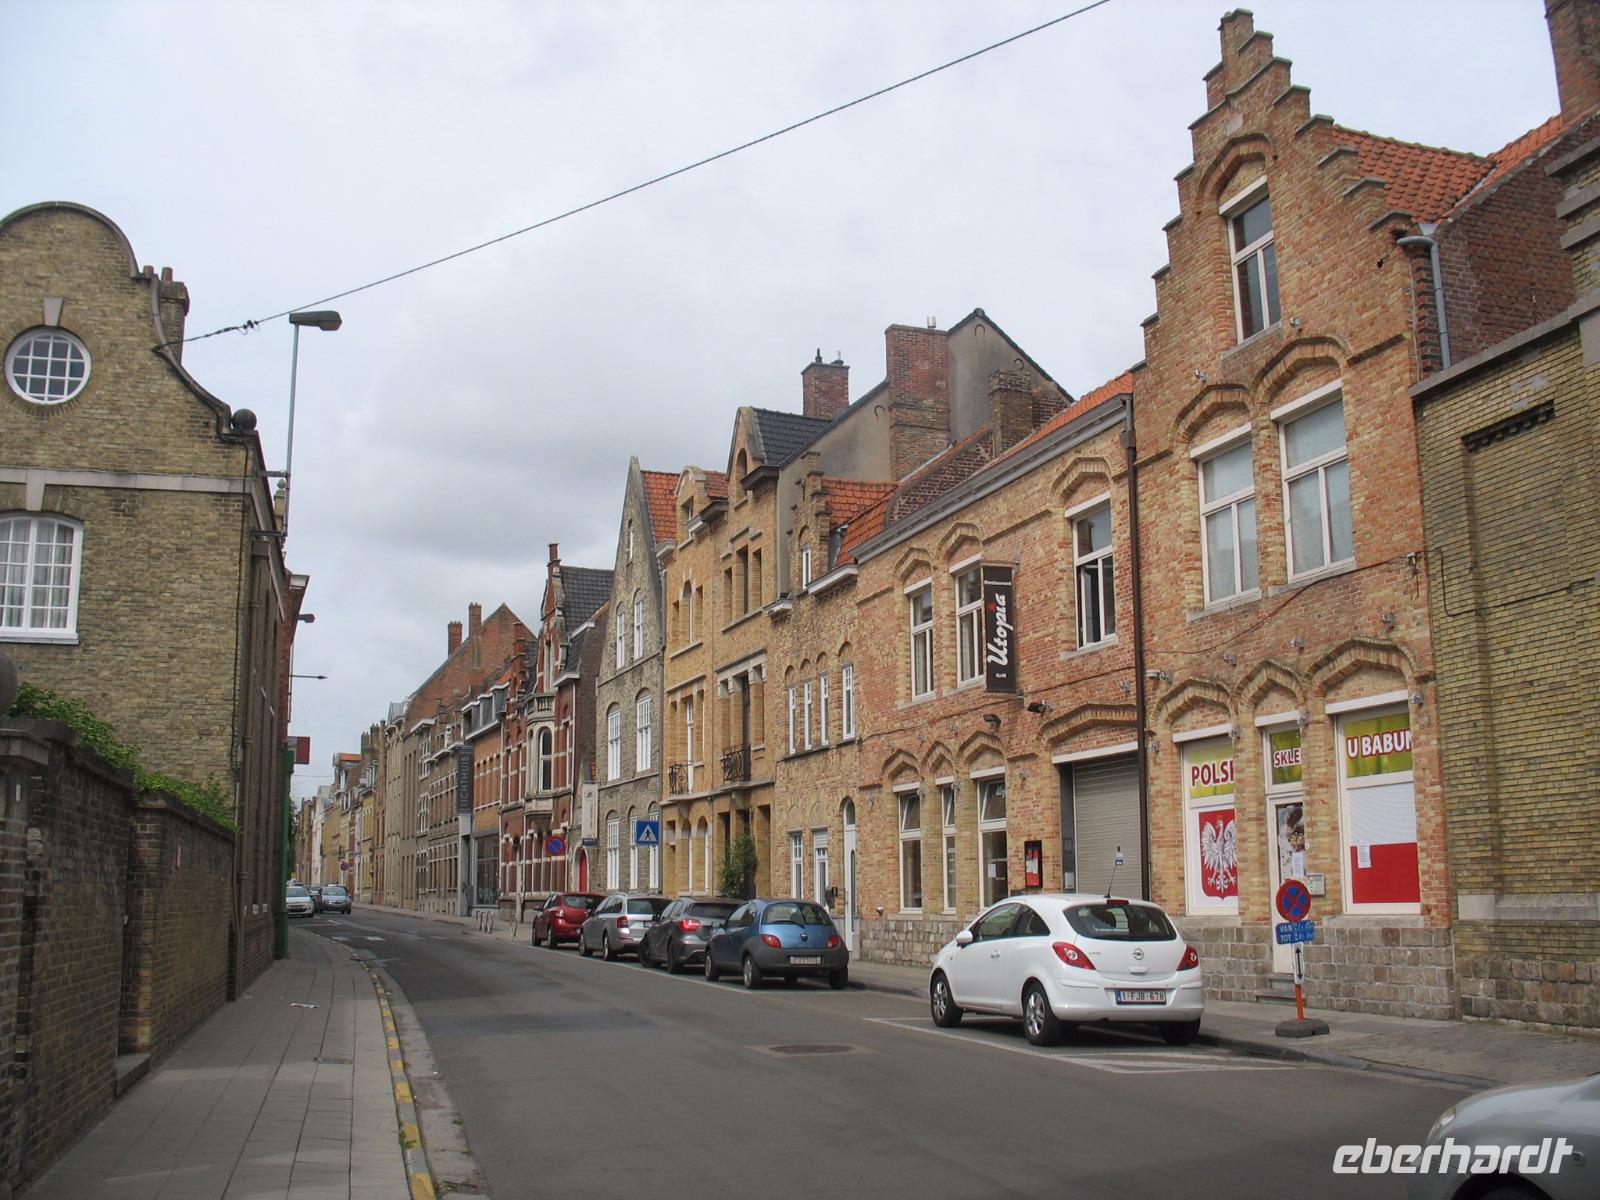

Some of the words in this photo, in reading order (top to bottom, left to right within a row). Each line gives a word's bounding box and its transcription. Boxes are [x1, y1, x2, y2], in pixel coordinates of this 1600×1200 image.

[987, 593, 1014, 666] Utopia
[1347, 737, 1358, 758] U
[1279, 924, 1293, 932] VAN
[1280, 934, 1292, 942] TOT
